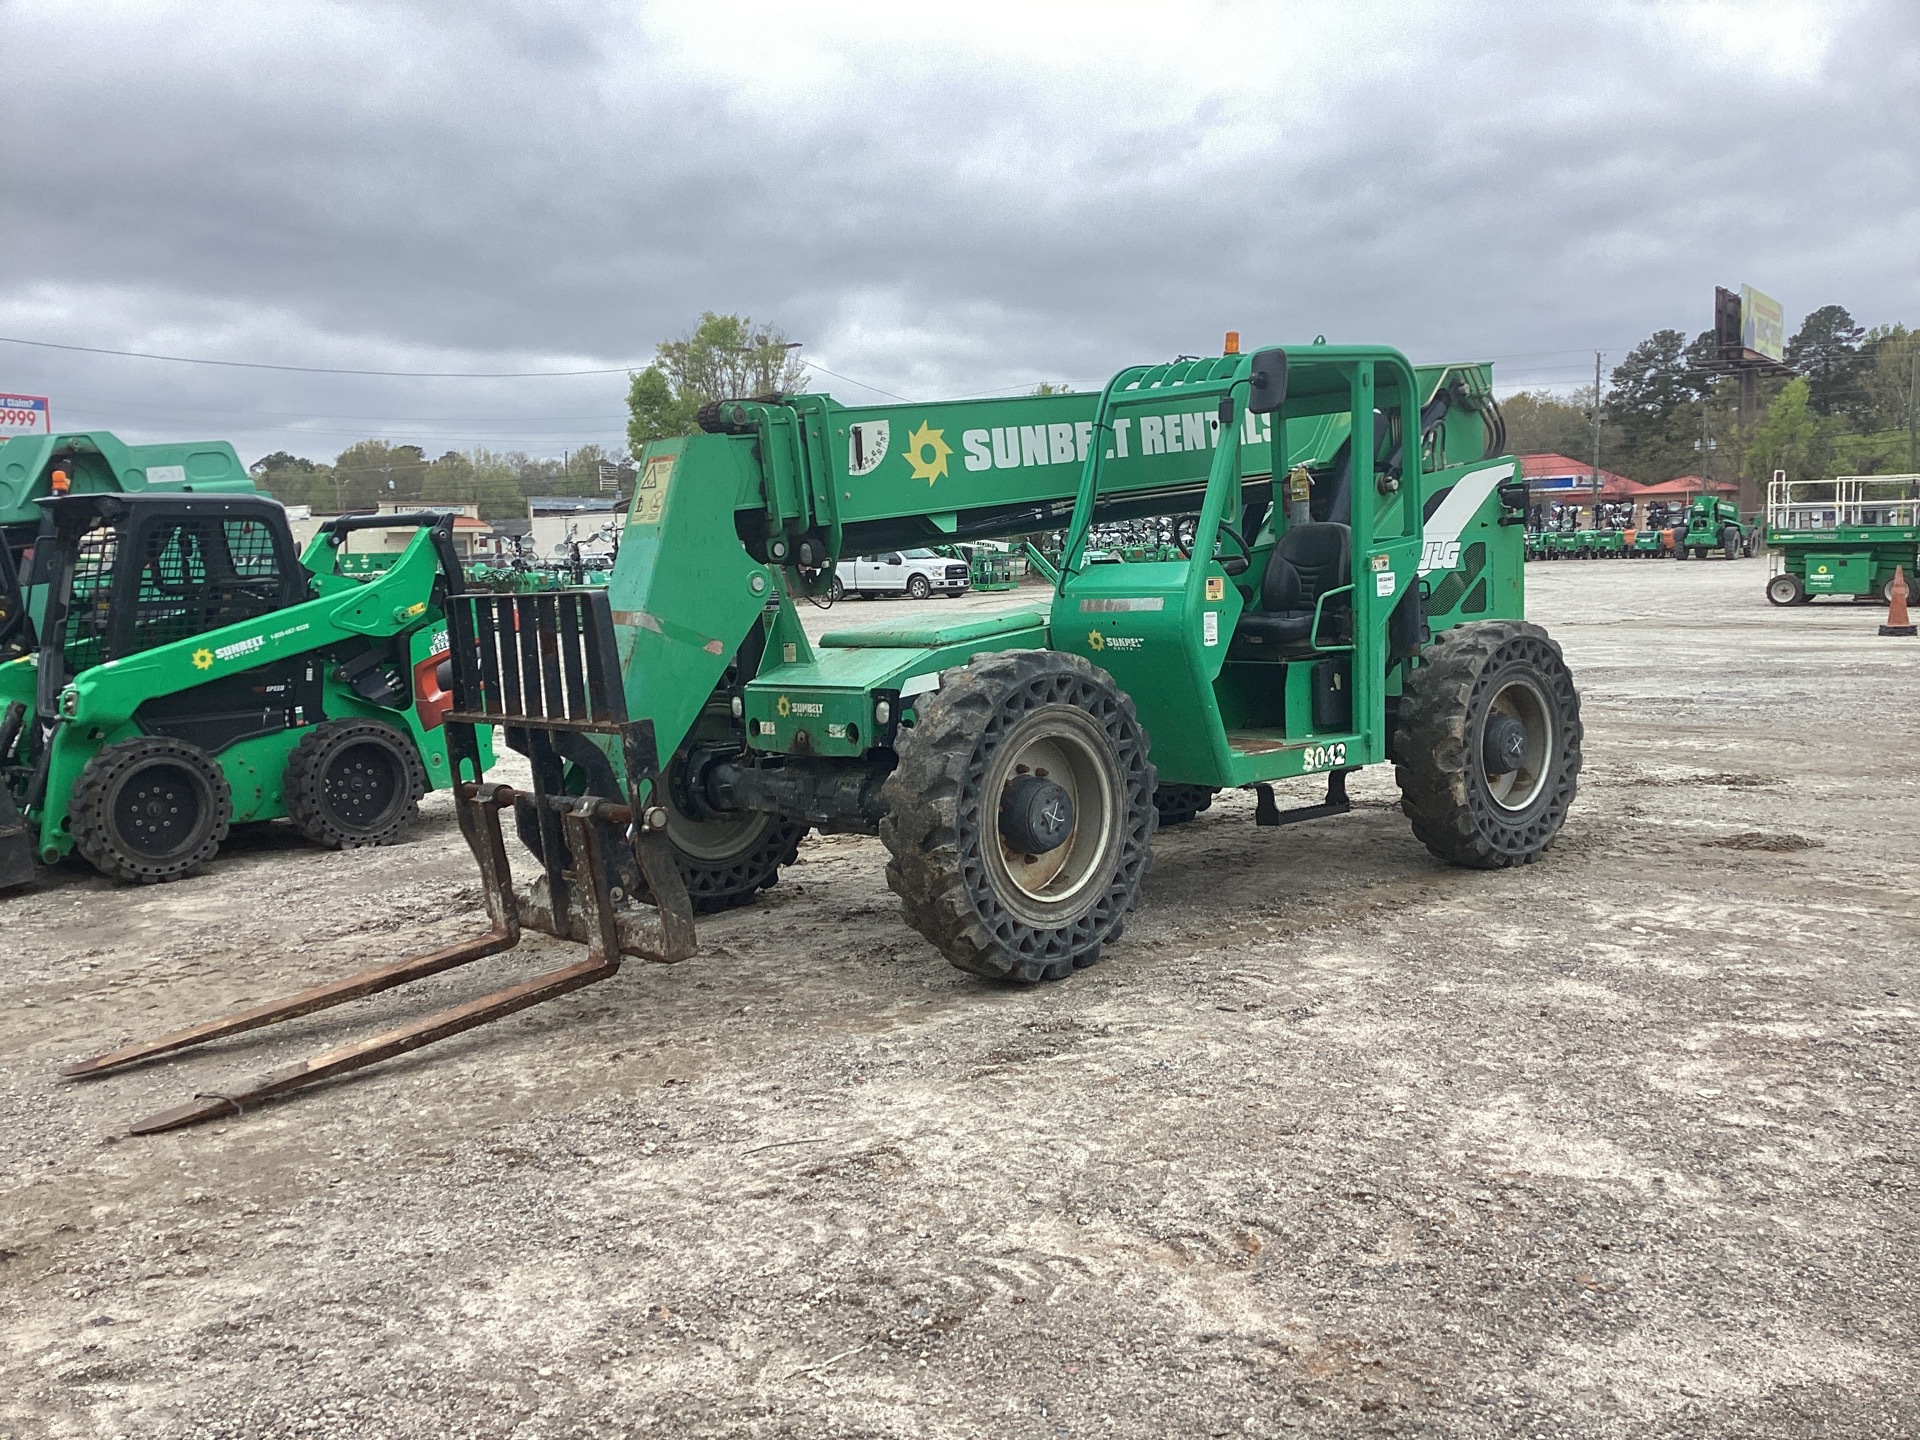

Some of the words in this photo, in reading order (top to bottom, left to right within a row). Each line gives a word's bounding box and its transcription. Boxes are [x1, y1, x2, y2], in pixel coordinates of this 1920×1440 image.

[962, 418, 1131, 472] SUNBET
[1140, 407, 1272, 456] RENTL
[1417, 541, 1462, 571] JLG
[214, 635, 266, 659] SUNBELT
[265, 684, 285, 693] SPEED
[1302, 741, 1347, 771] 8042
